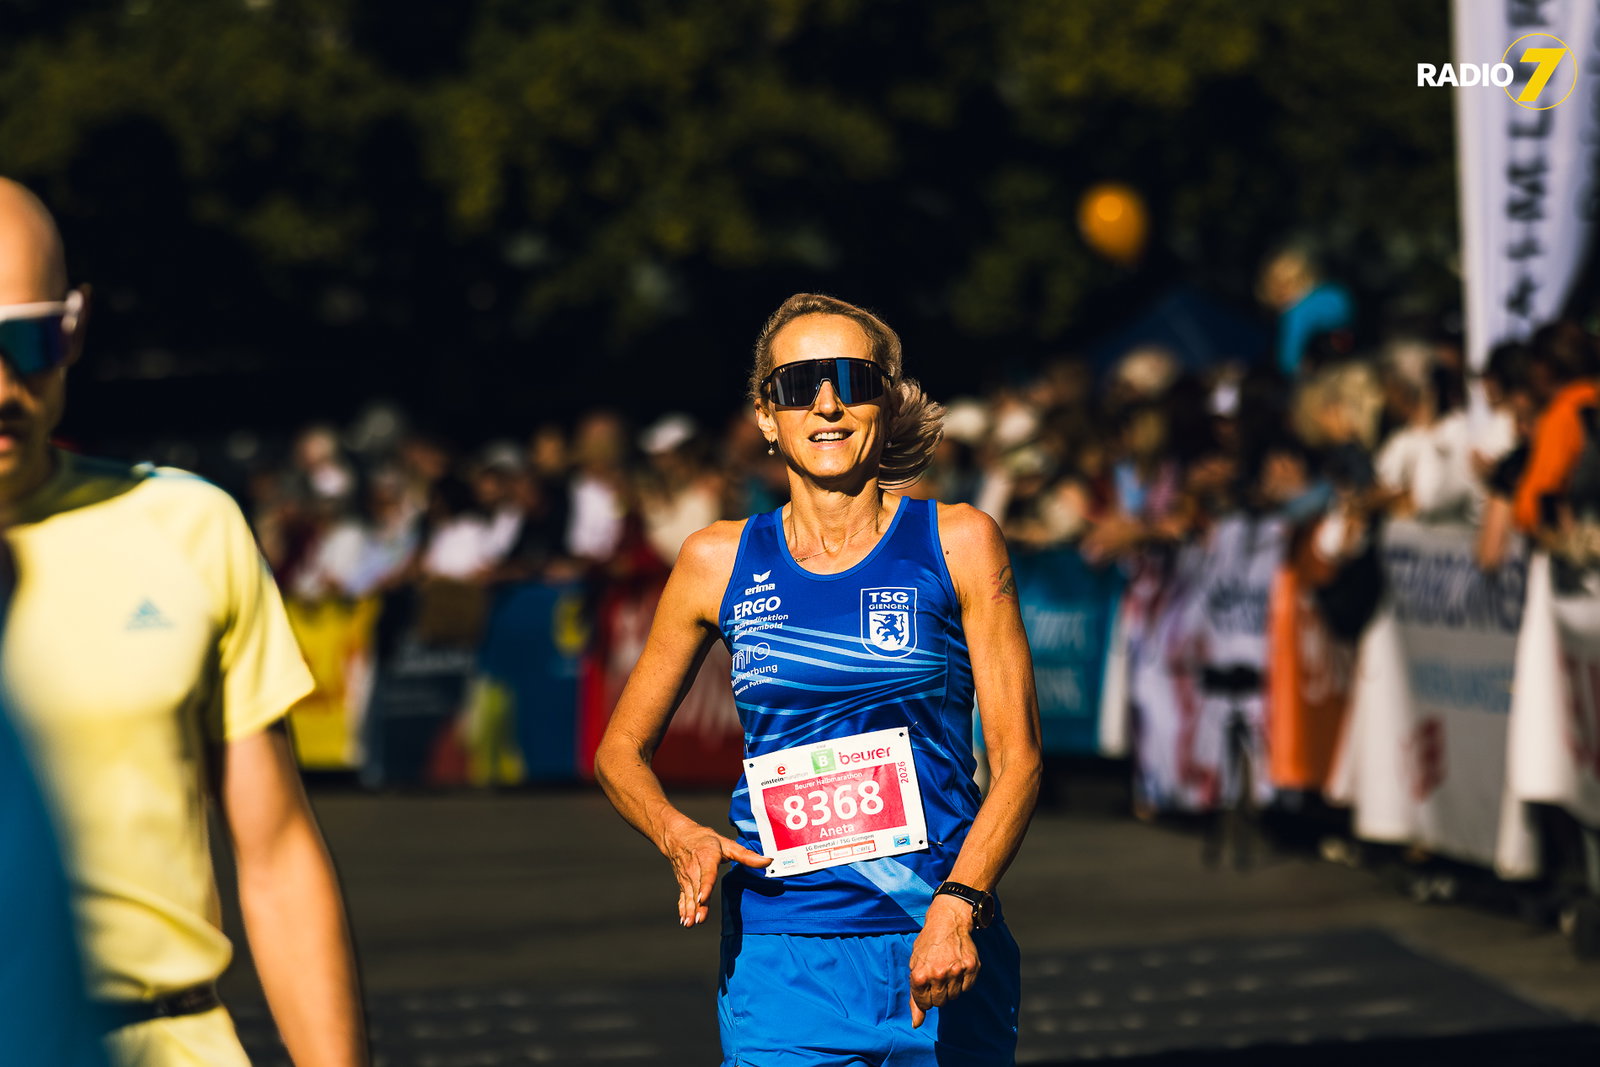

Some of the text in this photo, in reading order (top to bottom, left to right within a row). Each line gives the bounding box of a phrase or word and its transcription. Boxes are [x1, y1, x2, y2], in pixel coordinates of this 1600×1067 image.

[744, 583, 776, 596] erima
[868, 591, 909, 604] TSG
[733, 595, 782, 621] ERGO
[818, 754, 829, 767] B
[838, 746, 891, 765] beurer
[794, 771, 863, 791] Beurer Halbmarathon
[897, 761, 909, 784] 2026
[783, 780, 884, 831] 8368
[819, 824, 855, 839] Aneta
